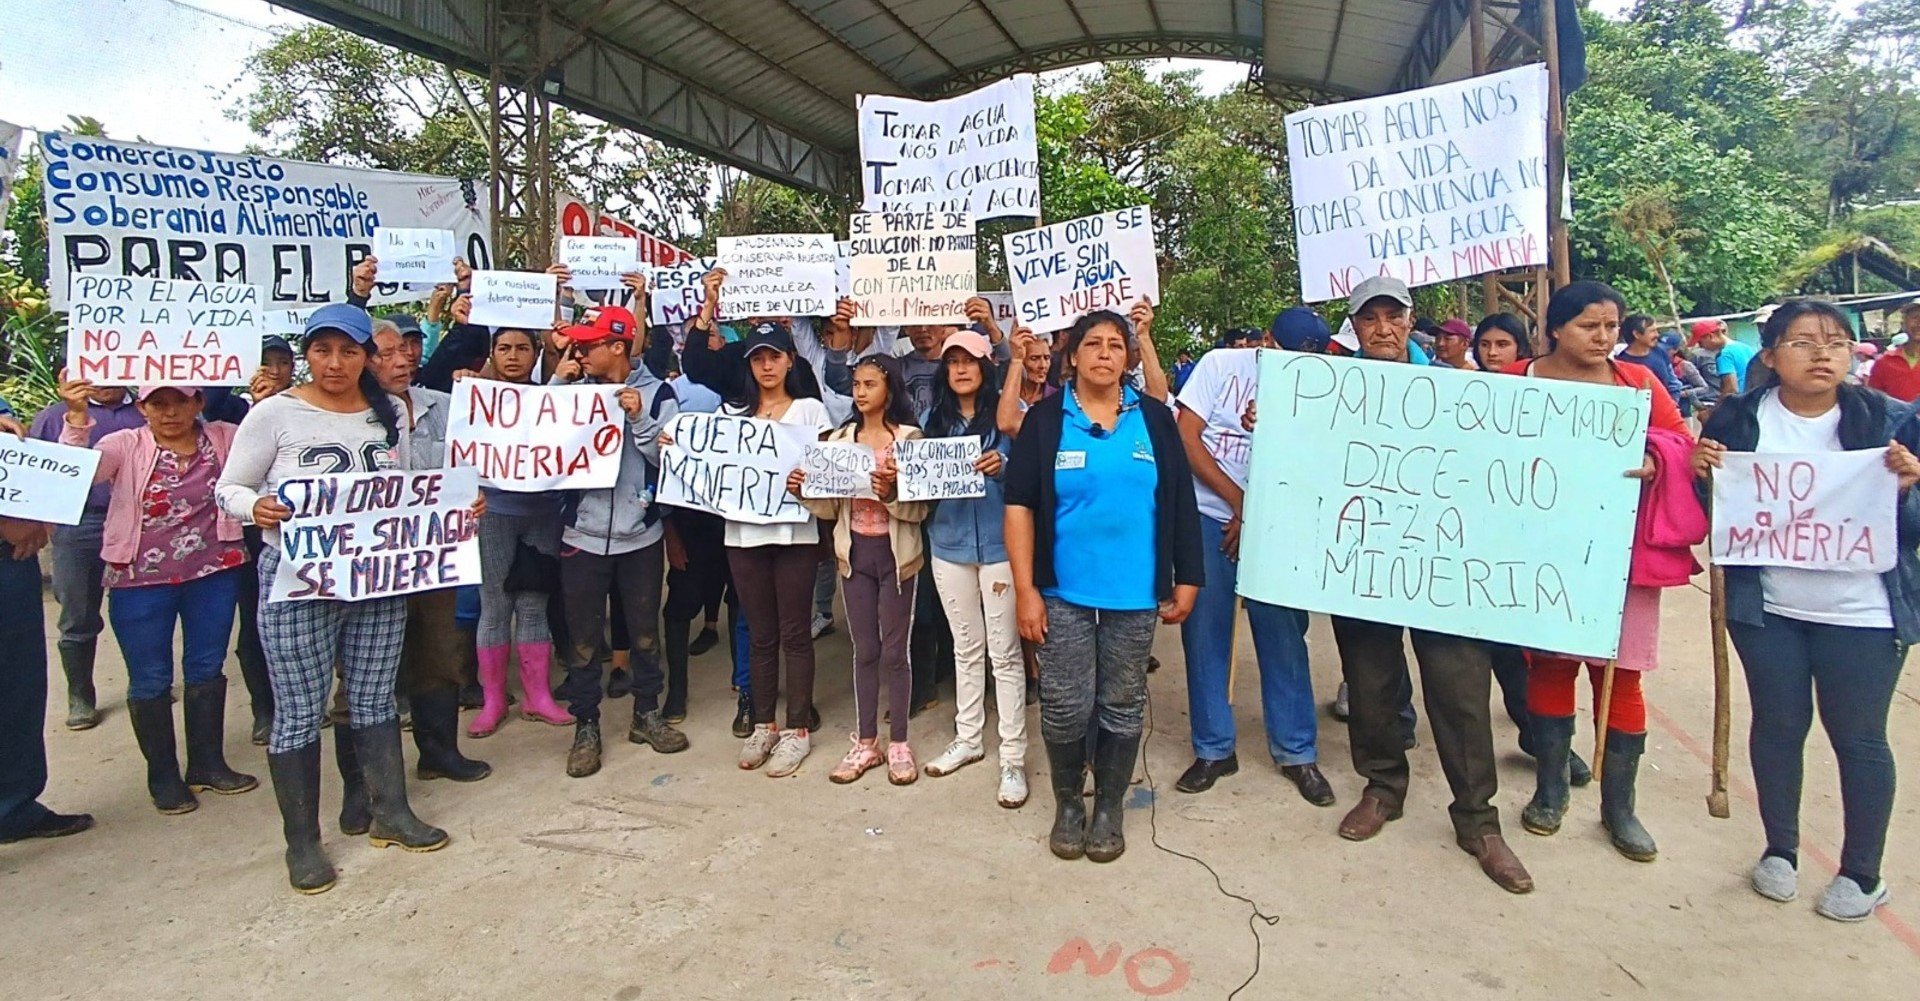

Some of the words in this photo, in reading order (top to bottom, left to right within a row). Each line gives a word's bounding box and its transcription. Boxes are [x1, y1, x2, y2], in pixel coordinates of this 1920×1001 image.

[874, 110, 941, 140] TOMAR
[959, 103, 1007, 134] AGUA
[1293, 110, 1374, 159] TOMAR
[1384, 97, 1447, 143] AGUA
[1461, 80, 1518, 129] NOS
[44, 132, 196, 170] Comercio
[198, 151, 285, 181] Justo
[900, 142, 937, 160] NOS
[948, 138, 967, 156] DA
[977, 125, 1019, 148] VIDA
[866, 160, 935, 197] TOMAR
[946, 157, 1039, 191] CONCIENCIA
[1347, 156, 1385, 191] DA
[1397, 139, 1472, 180] VIDA
[47, 161, 210, 198] Consumo
[214, 175, 368, 211] Responsable
[986, 187, 1039, 213] AGUA
[1378, 167, 1513, 222] CONCIENCIA
[236, 202, 379, 239] Alimentaria
[853, 213, 872, 234] SE
[882, 212, 935, 232] PARTE
[942, 213, 967, 229] DE
[1012, 226, 1053, 257] SIN
[1065, 216, 1104, 245] ORO
[1115, 206, 1144, 230] SE
[1365, 217, 1439, 260] DARÁ
[1449, 202, 1525, 246] AGUA
[389, 232, 404, 246] No
[426, 238, 436, 250] la
[567, 239, 585, 250] Que
[594, 242, 626, 251] nuestra
[721, 251, 796, 264] CONSERVAR
[809, 238, 824, 249] A
[929, 235, 945, 252] NO
[947, 234, 977, 251] PARTE
[1076, 241, 1110, 268] SIN
[1408, 255, 1443, 285] LA
[1452, 228, 1539, 279] MINERÍA
[64, 234, 247, 300] PARA
[272, 244, 331, 302] EL
[590, 255, 607, 263] sea
[739, 266, 784, 279] MADRE
[886, 256, 912, 272] DE
[917, 256, 936, 272] LA
[1072, 260, 1127, 291] AGUA
[76, 276, 133, 302] POR
[150, 280, 177, 302] EL
[188, 283, 257, 304] AGUA
[721, 282, 816, 297] NATURALEZA
[766, 301, 781, 312] DE
[782, 298, 825, 314] VIDA
[1022, 297, 1051, 322] SE
[1059, 277, 1135, 317] MUERE
[75, 303, 126, 324] POR
[140, 308, 170, 324] LA
[187, 309, 254, 327] VIDA
[853, 299, 875, 318] NO
[903, 297, 965, 318] Mineria
[84, 329, 121, 351] NO
[138, 330, 158, 351] A
[182, 330, 221, 349] LA
[79, 354, 242, 382] MINERIA
[469, 384, 520, 429] NO
[536, 393, 557, 426] A
[571, 392, 609, 426] LA
[675, 414, 778, 458] FUERA
[896, 440, 914, 462] NO
[450, 439, 591, 480] MINERIA
[862, 454, 872, 472] a
[905, 461, 928, 485] gas
[277, 477, 338, 522] SIN
[345, 475, 404, 514] ORO
[407, 474, 443, 507] SE
[660, 449, 802, 517] MINERIA
[928, 481, 938, 497] la
[1753, 461, 1815, 503] NO
[1755, 510, 1772, 528] a
[1789, 500, 1815, 525] la
[283, 521, 364, 562] VIVE,
[370, 515, 421, 552] SIN
[1725, 517, 1875, 564] MINERÍA
[287, 561, 336, 598] SE
[350, 546, 460, 598] MUERE
[1322, 548, 1573, 623] MINERIA
[1046, 936, 1191, 996] NO
